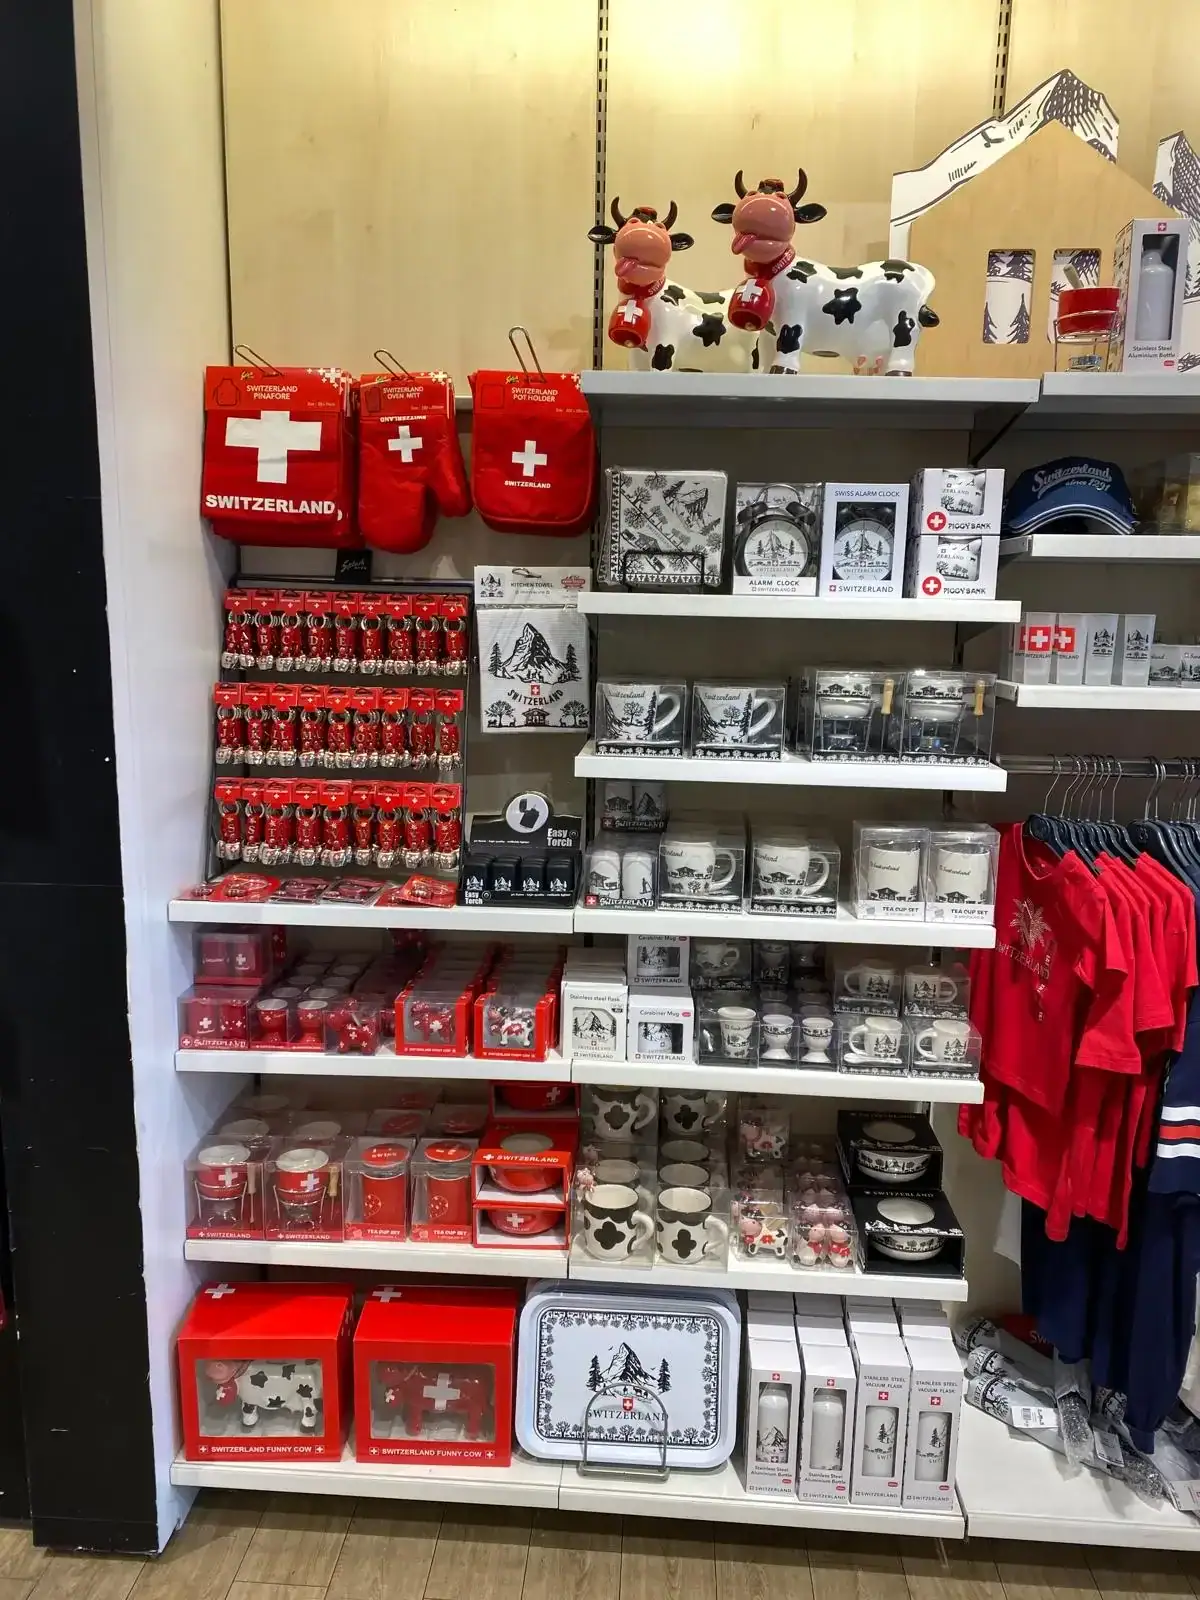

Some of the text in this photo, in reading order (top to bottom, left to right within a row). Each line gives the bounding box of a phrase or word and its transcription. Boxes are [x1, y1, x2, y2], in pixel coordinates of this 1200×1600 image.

[246, 385, 298, 393] SWITZERLAND
[383, 386, 424, 394] SWITZERLAND
[511, 387, 558, 396] SWITZERLAND
[528, 395, 556, 403] HOLDER
[1032, 463, 1111, 493] Switzerland
[504, 480, 551, 489] SWITZERLAND
[205, 494, 336, 515] SWITZERLAND
[838, 585, 894, 593] SWITZERLAND
[507, 688, 564, 706] SWITZERLAND
[704, 692, 741, 701] Switzerland
[547, 828, 569, 839] Easy
[547, 837, 573, 847] Torch
[465, 890, 480, 899] Easy
[465, 897, 483, 905] Torch
[496, 1155, 559, 1164] SWITZERLAND
[381, 1448, 435, 1456] SWITZERLAND
